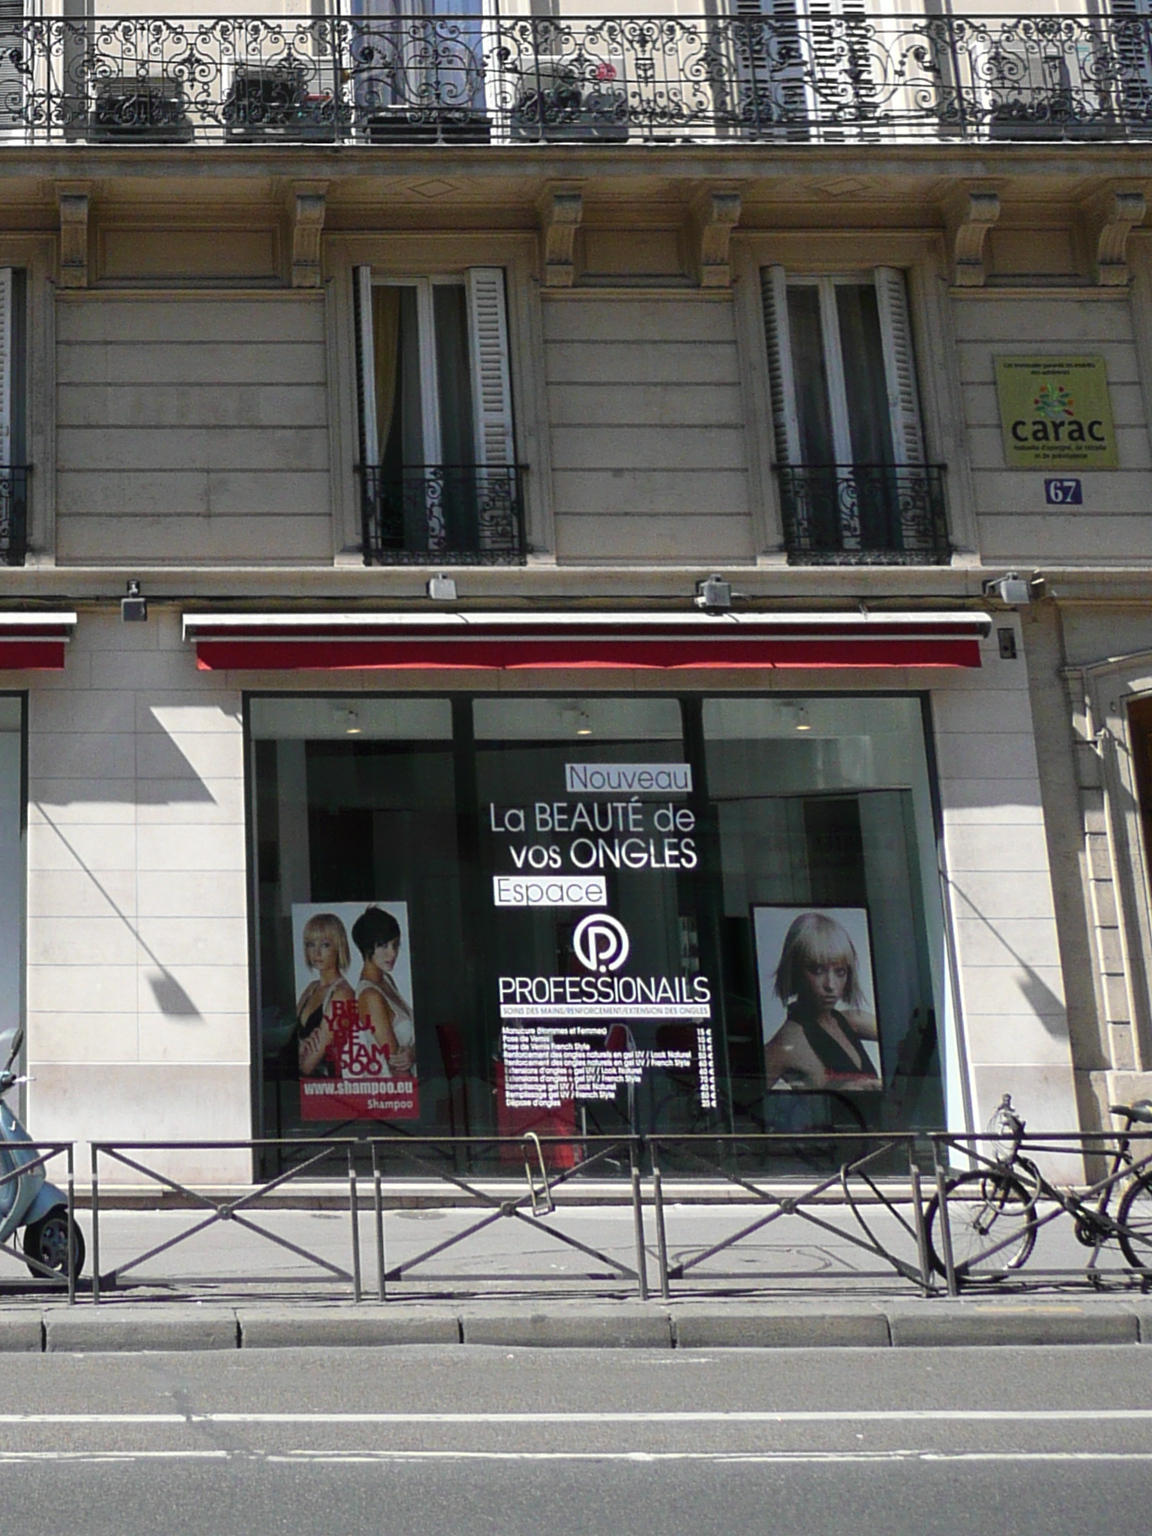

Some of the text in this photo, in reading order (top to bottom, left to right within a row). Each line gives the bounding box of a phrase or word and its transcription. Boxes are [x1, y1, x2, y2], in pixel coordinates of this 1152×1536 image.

[1011, 419, 1105, 442] carac
[1049, 480, 1077, 503] 67
[569, 765, 689, 790] Nouveau
[489, 795, 696, 832] La BEAUTÉ de
[509, 837, 698, 869] vos ONGLES
[496, 877, 604, 907] Espace
[498, 976, 711, 1003] PROFESSIONAILS
[331, 1000, 358, 1017] BE
[503, 1006, 525, 1015] SOINS
[526, 1006, 539, 1015] DES
[664, 1007, 678, 1015] DES
[679, 1007, 709, 1015] ONGLES
[503, 1035, 518, 1043] Pose
[325, 1043, 390, 1061] SHAM
[334, 1059, 383, 1077] POO
[304, 1079, 414, 1095] www.shampoo.eu
[367, 1099, 414, 1111] Shampoo
